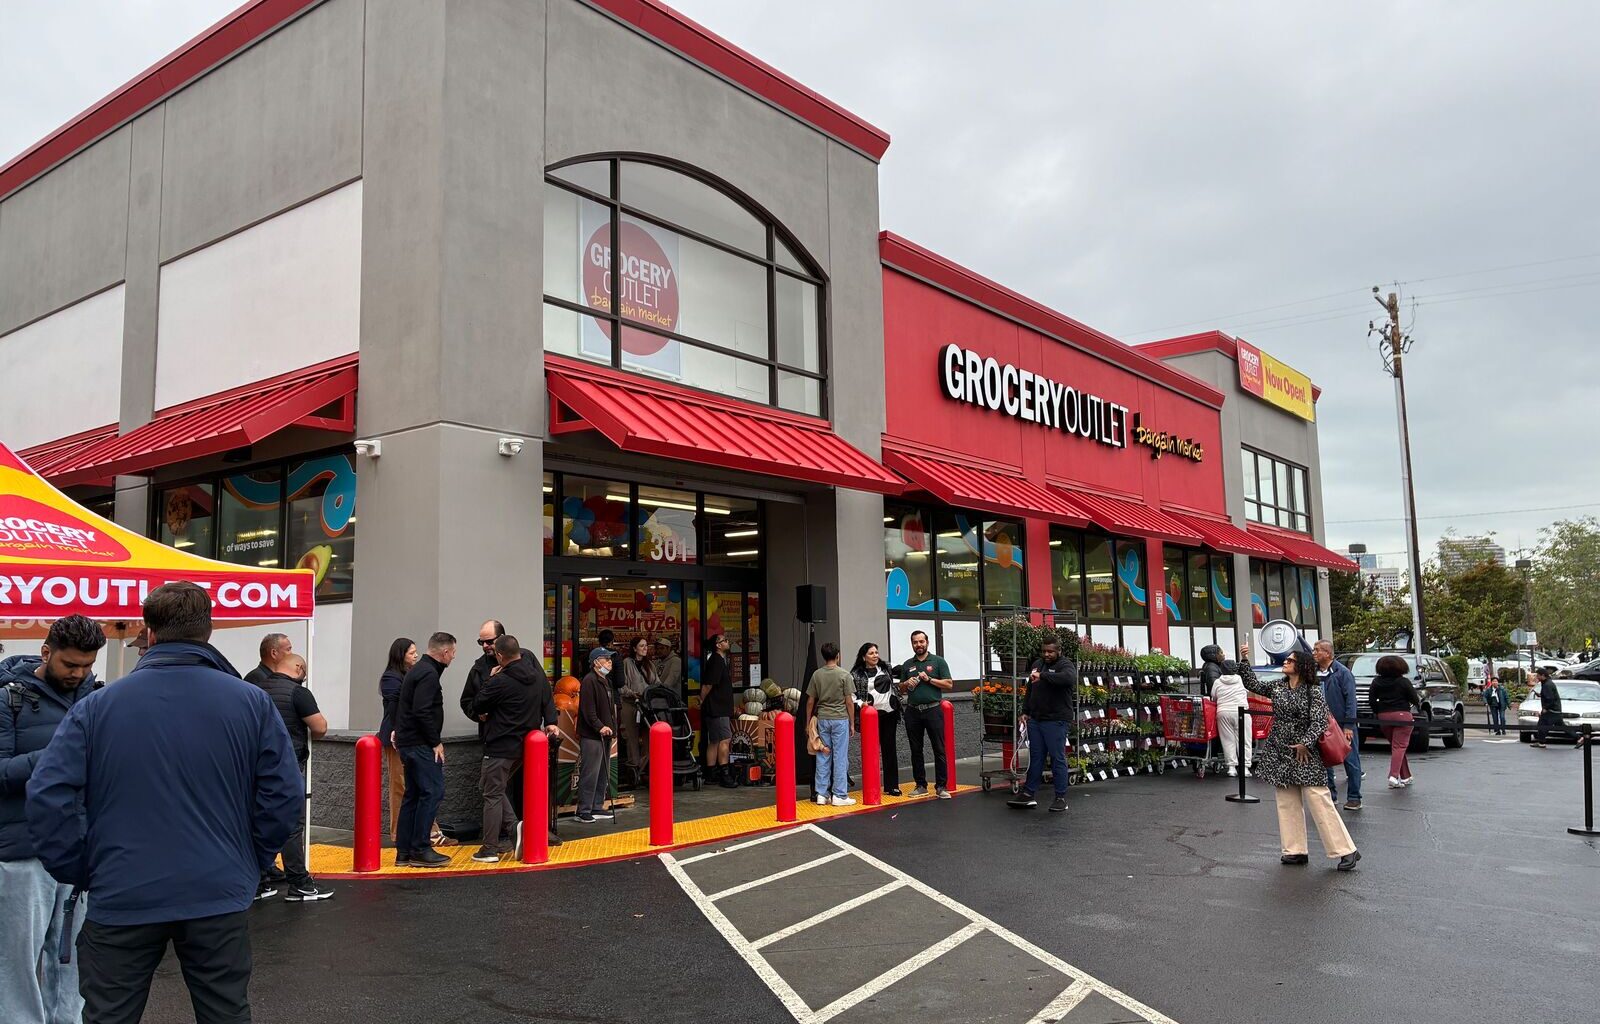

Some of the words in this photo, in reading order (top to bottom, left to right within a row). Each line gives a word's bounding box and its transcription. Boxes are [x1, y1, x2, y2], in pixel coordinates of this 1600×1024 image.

[590, 286, 636, 317] baain
[638, 305, 672, 327] market
[1265, 366, 1283, 392] Now
[1284, 376, 1306, 404] Open!
[1133, 412, 1175, 459] bargain
[1176, 436, 1204, 461] market
[0, 517, 96, 542] ROCERY
[0, 541, 54, 551] argain
[56, 544, 116, 557] market
[226, 542, 234, 552] of
[234, 541, 251, 552] ways
[251, 540, 259, 549] to
[259, 539, 275, 548] save
[650, 536, 688, 562] 301
[0, 575, 297, 608] RYOUTL.COM
[609, 607, 635, 620] 70%
